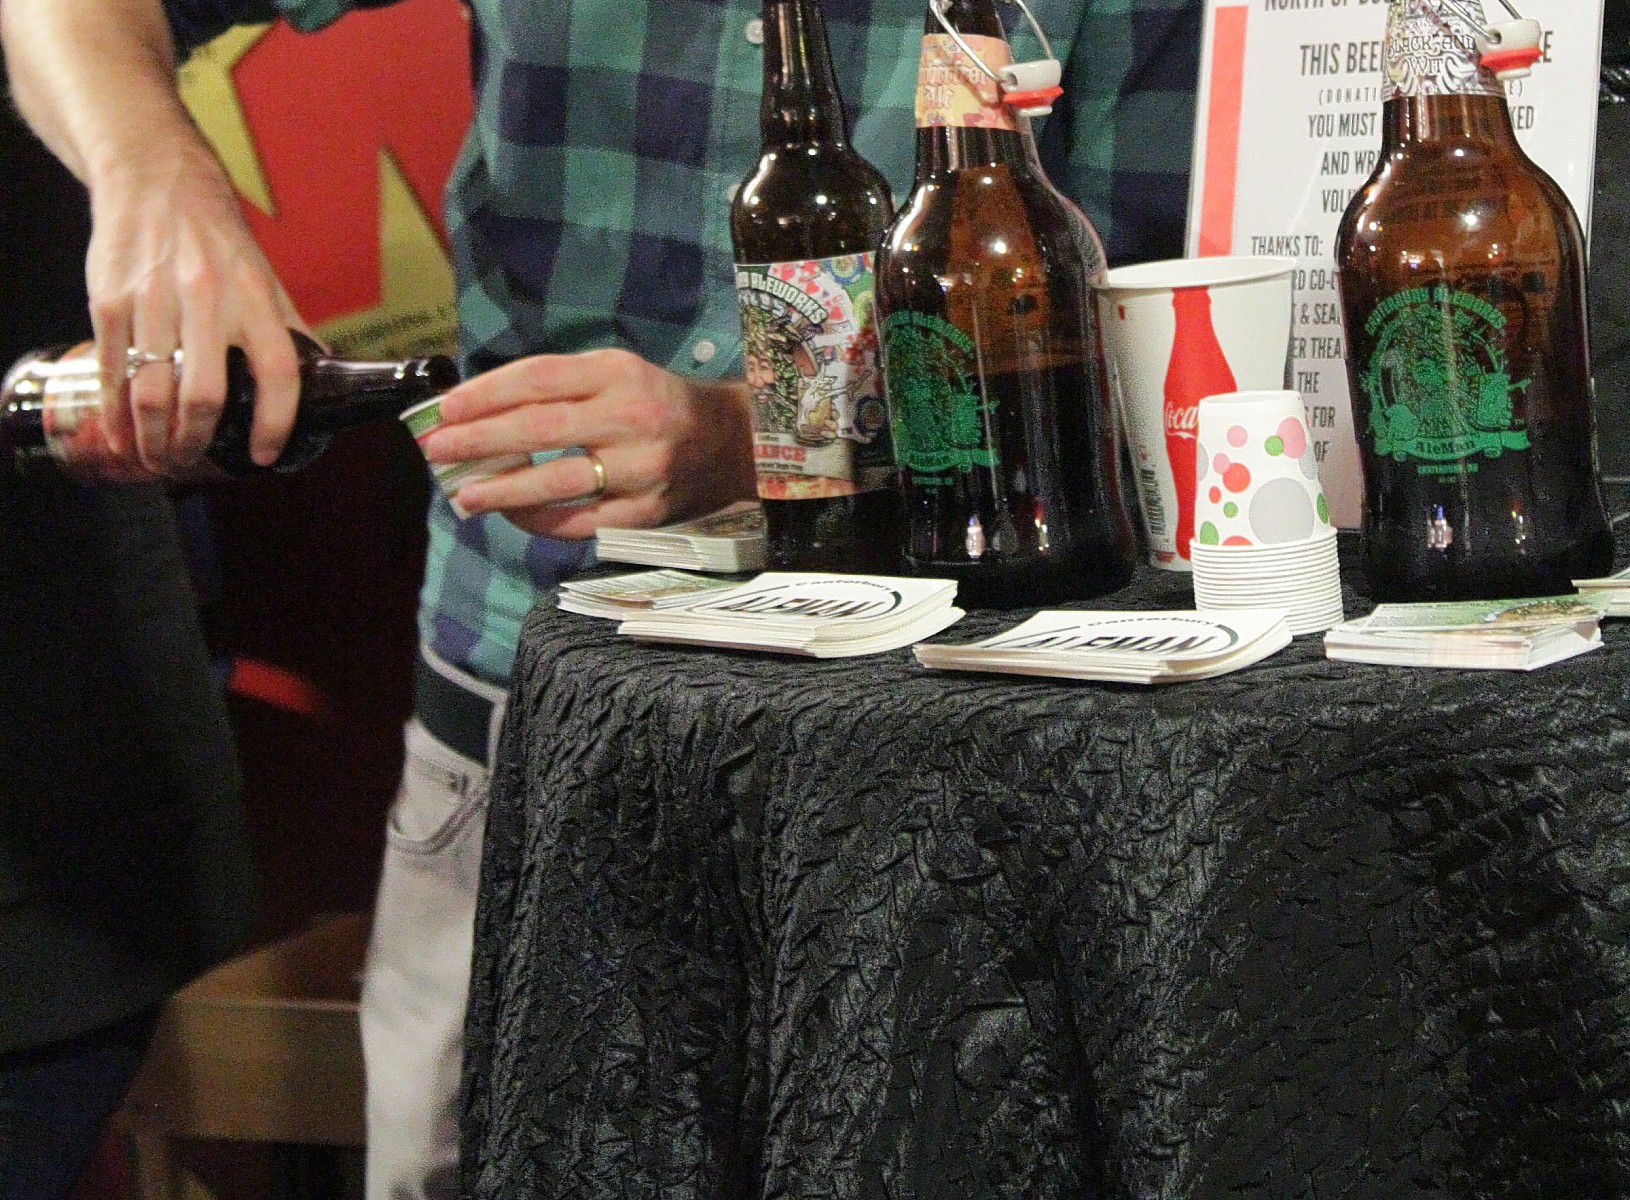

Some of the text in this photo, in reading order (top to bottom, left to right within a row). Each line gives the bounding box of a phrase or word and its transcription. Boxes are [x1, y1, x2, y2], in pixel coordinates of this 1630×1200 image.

[1300, 41, 1384, 75] THIS BEE
[1409, 55, 1443, 75] WIT
[1308, 114, 1334, 138] YOU
[1339, 112, 1377, 137] MUST
[1320, 151, 1350, 176] AND
[1251, 235, 1323, 256] THANKS TO:
[1300, 303, 1310, 325] &
[1297, 371, 1320, 393] THE
[1312, 406, 1336, 428] FOR
[1313, 440, 1330, 463] OF
